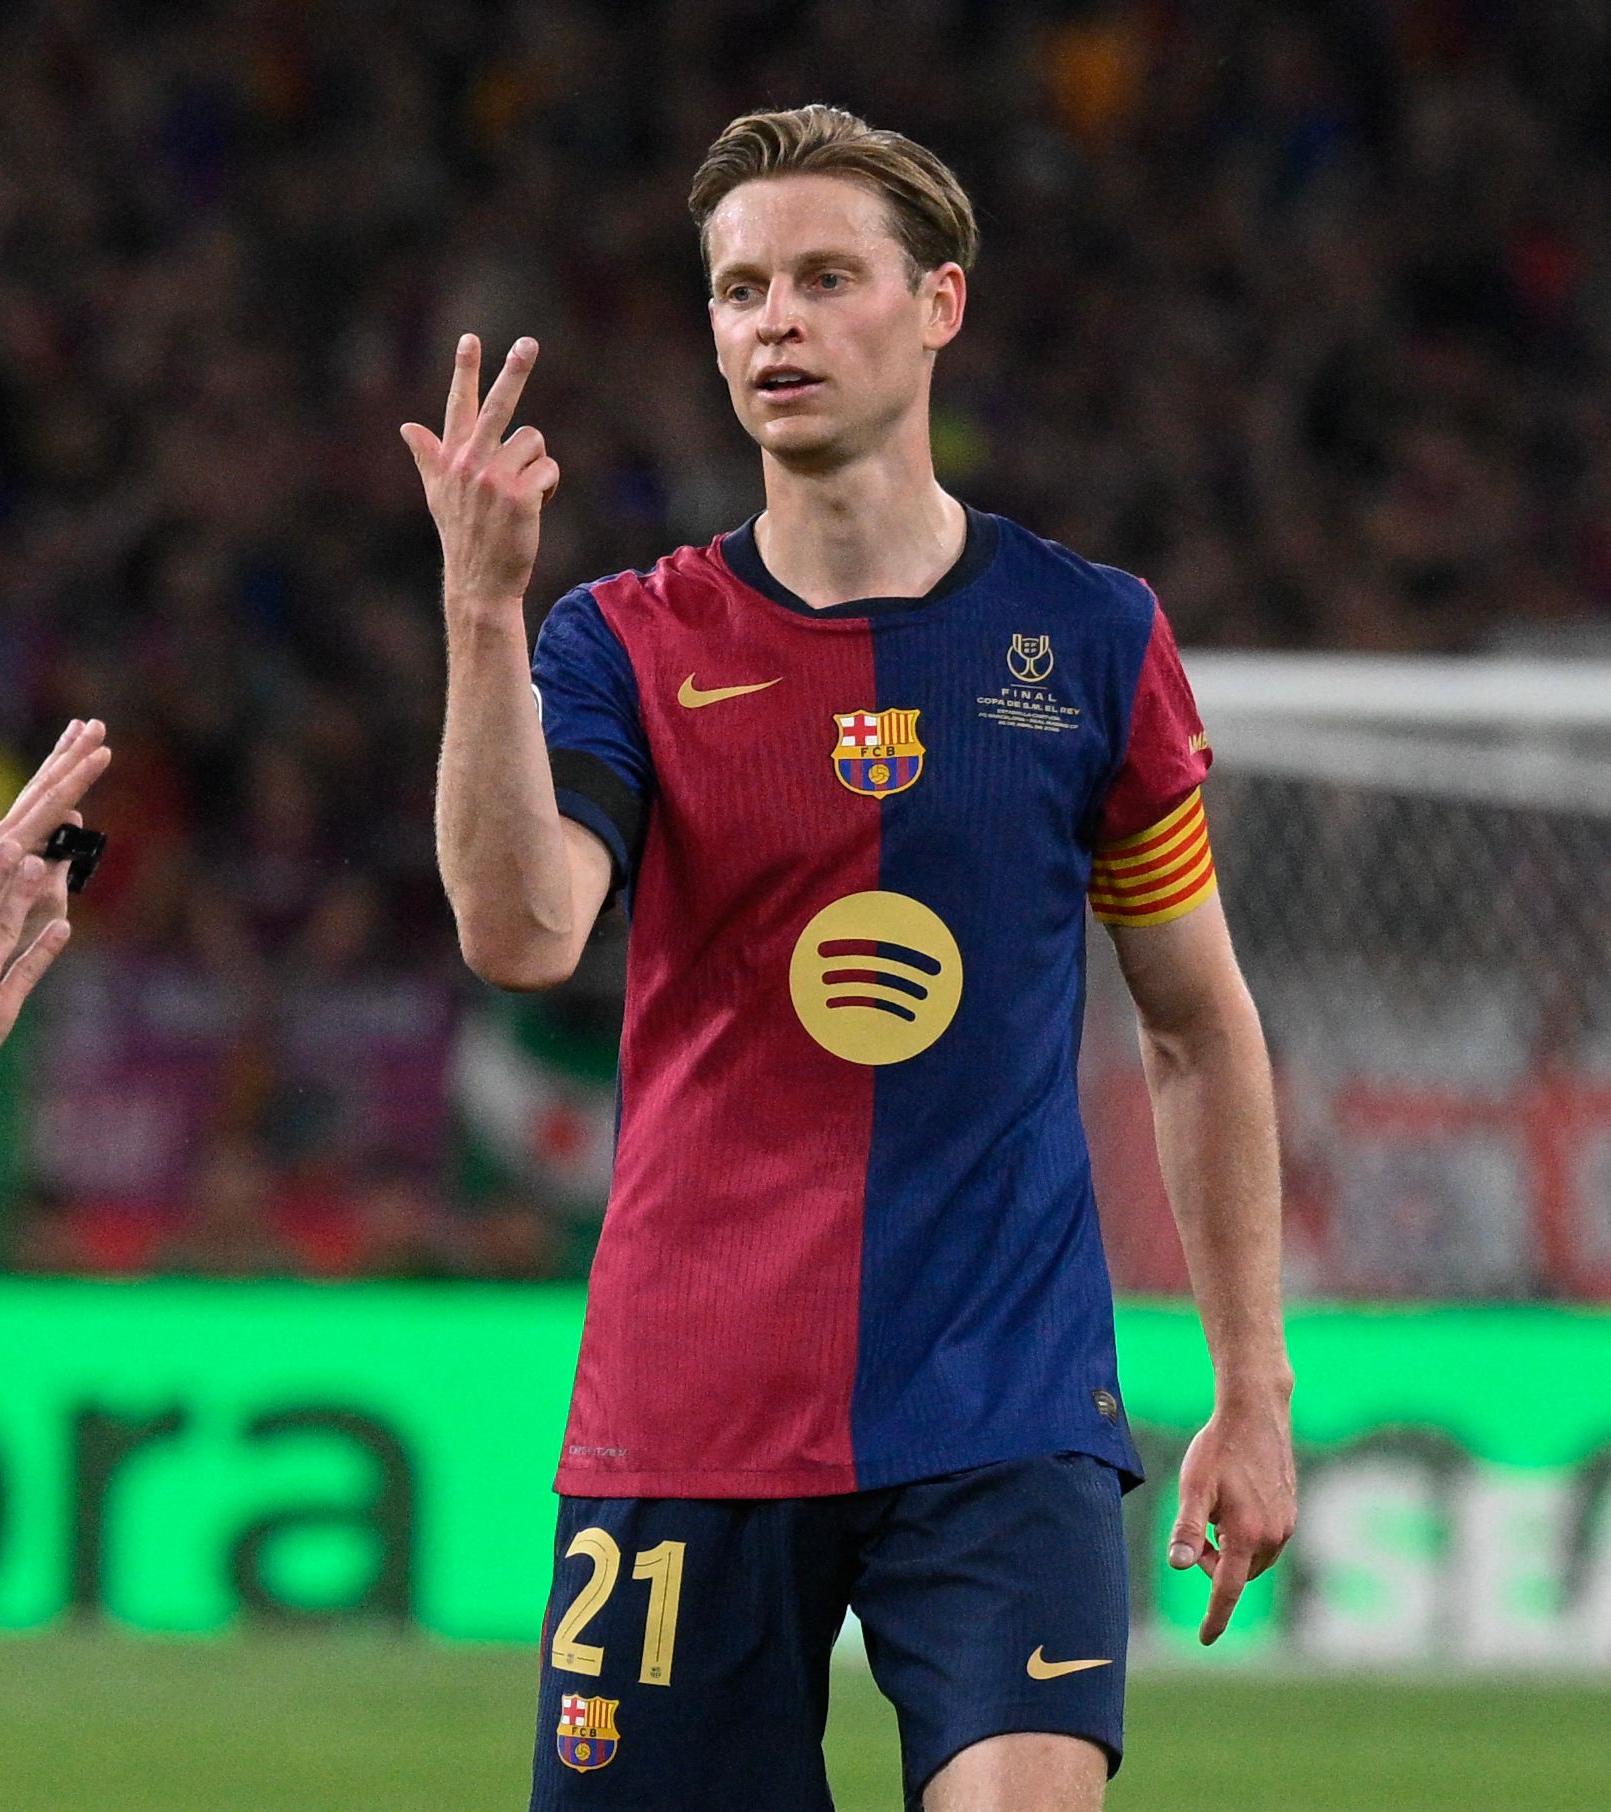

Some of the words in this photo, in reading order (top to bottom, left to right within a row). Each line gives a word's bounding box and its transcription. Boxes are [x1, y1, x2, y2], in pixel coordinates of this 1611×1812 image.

[1001, 688, 1057, 702] FINAL
[976, 697, 1005, 706] COPA
[1007, 700, 1021, 708] DE
[1045, 704, 1058, 713] EL
[1060, 706, 1081, 715] REY
[860, 747, 896, 757] FCB
[551, 1527, 687, 1687] 21
[572, 1727, 597, 1737] FCB
